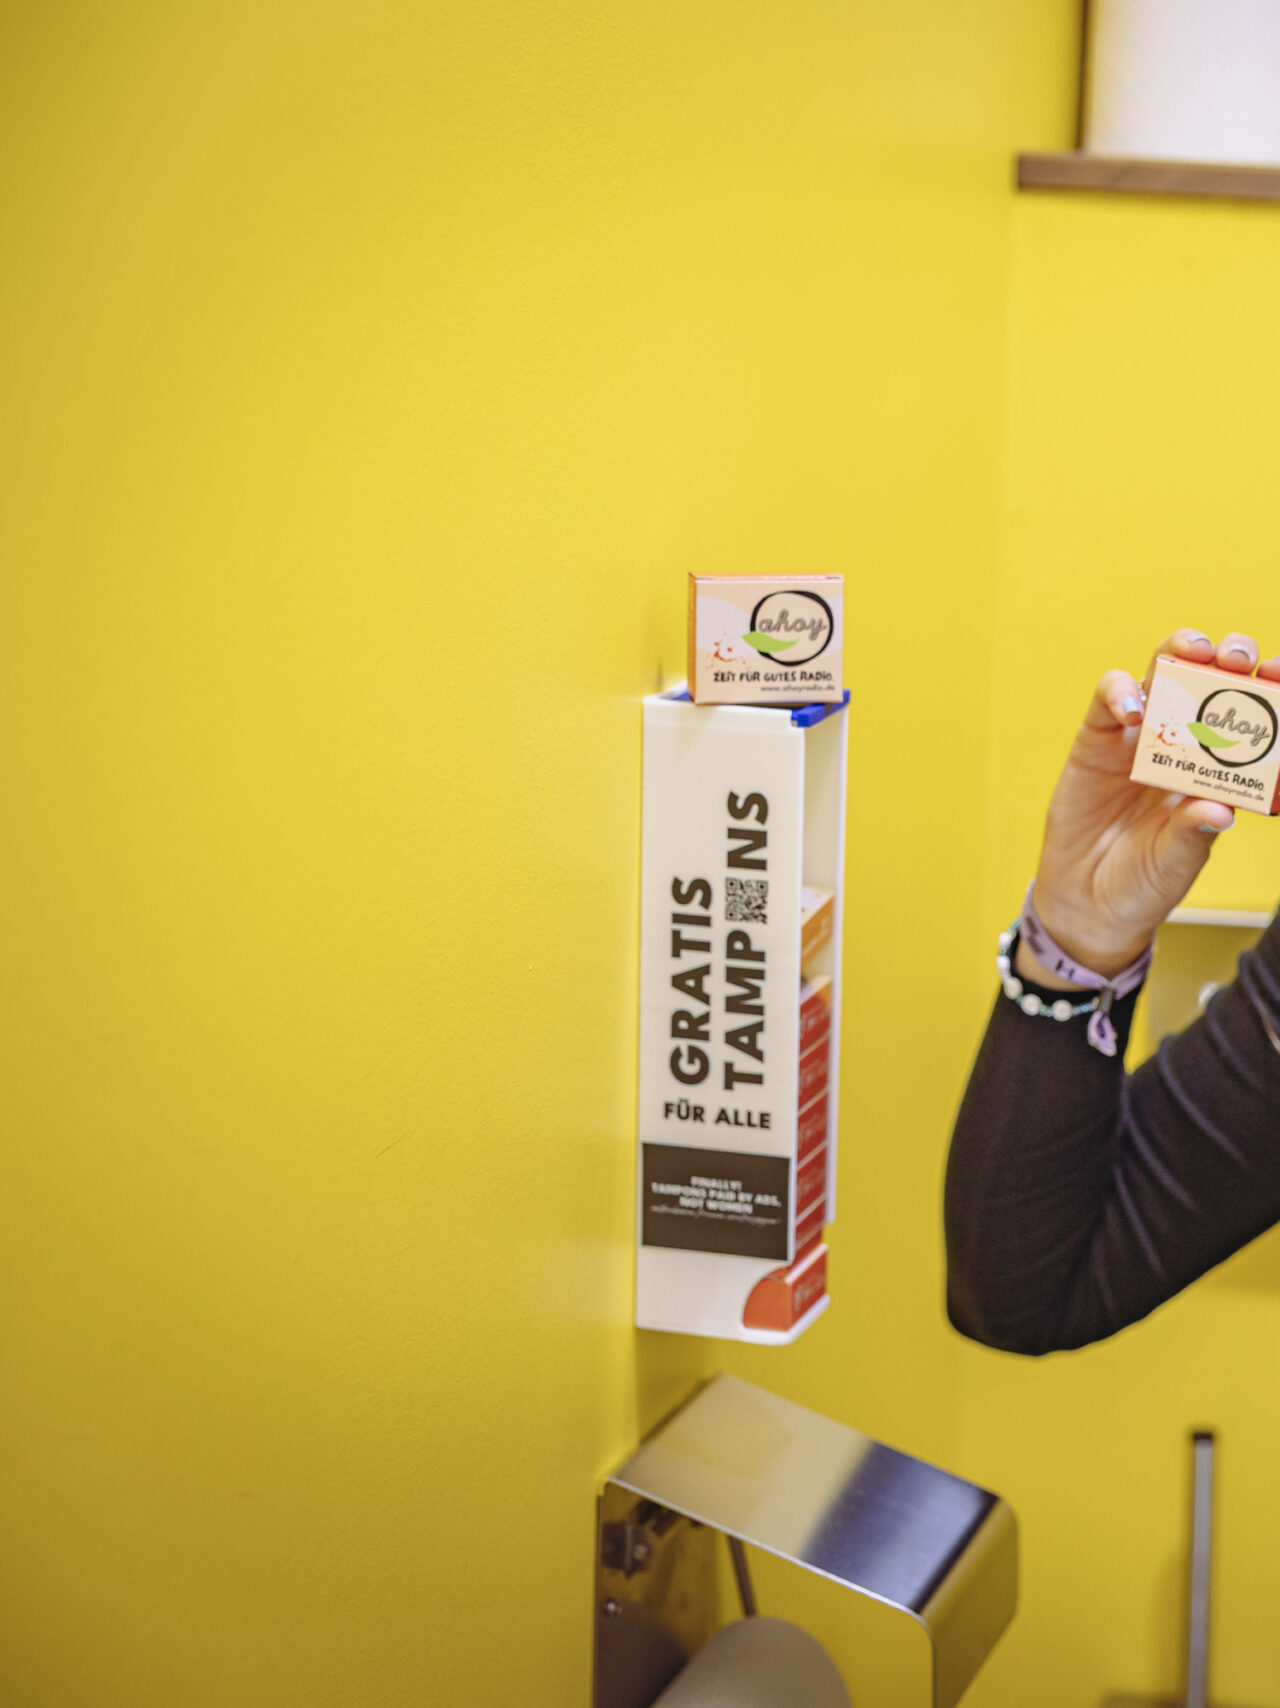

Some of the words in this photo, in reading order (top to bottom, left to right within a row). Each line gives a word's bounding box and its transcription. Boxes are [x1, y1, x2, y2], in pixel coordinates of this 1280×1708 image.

[758, 608, 827, 641] ahoy
[739, 670, 761, 682] FÜR
[764, 670, 797, 682] GUTES
[760, 683, 835, 693] www.ahoyradio.de
[1204, 707, 1270, 747] ahoy
[1175, 759, 1196, 774] FÜR
[1198, 766, 1230, 783] GUTES
[1193, 778, 1265, 802] www.ahoyradio.de
[670, 875, 713, 1085] GRATIS
[663, 1098, 706, 1124] FÜR
[714, 1107, 771, 1130] ALLE
[679, 1196, 704, 1209] NOT
[706, 1199, 753, 1215] WOMEN
[708, 1188, 736, 1202] PAID
[737, 1192, 753, 1203] BY
